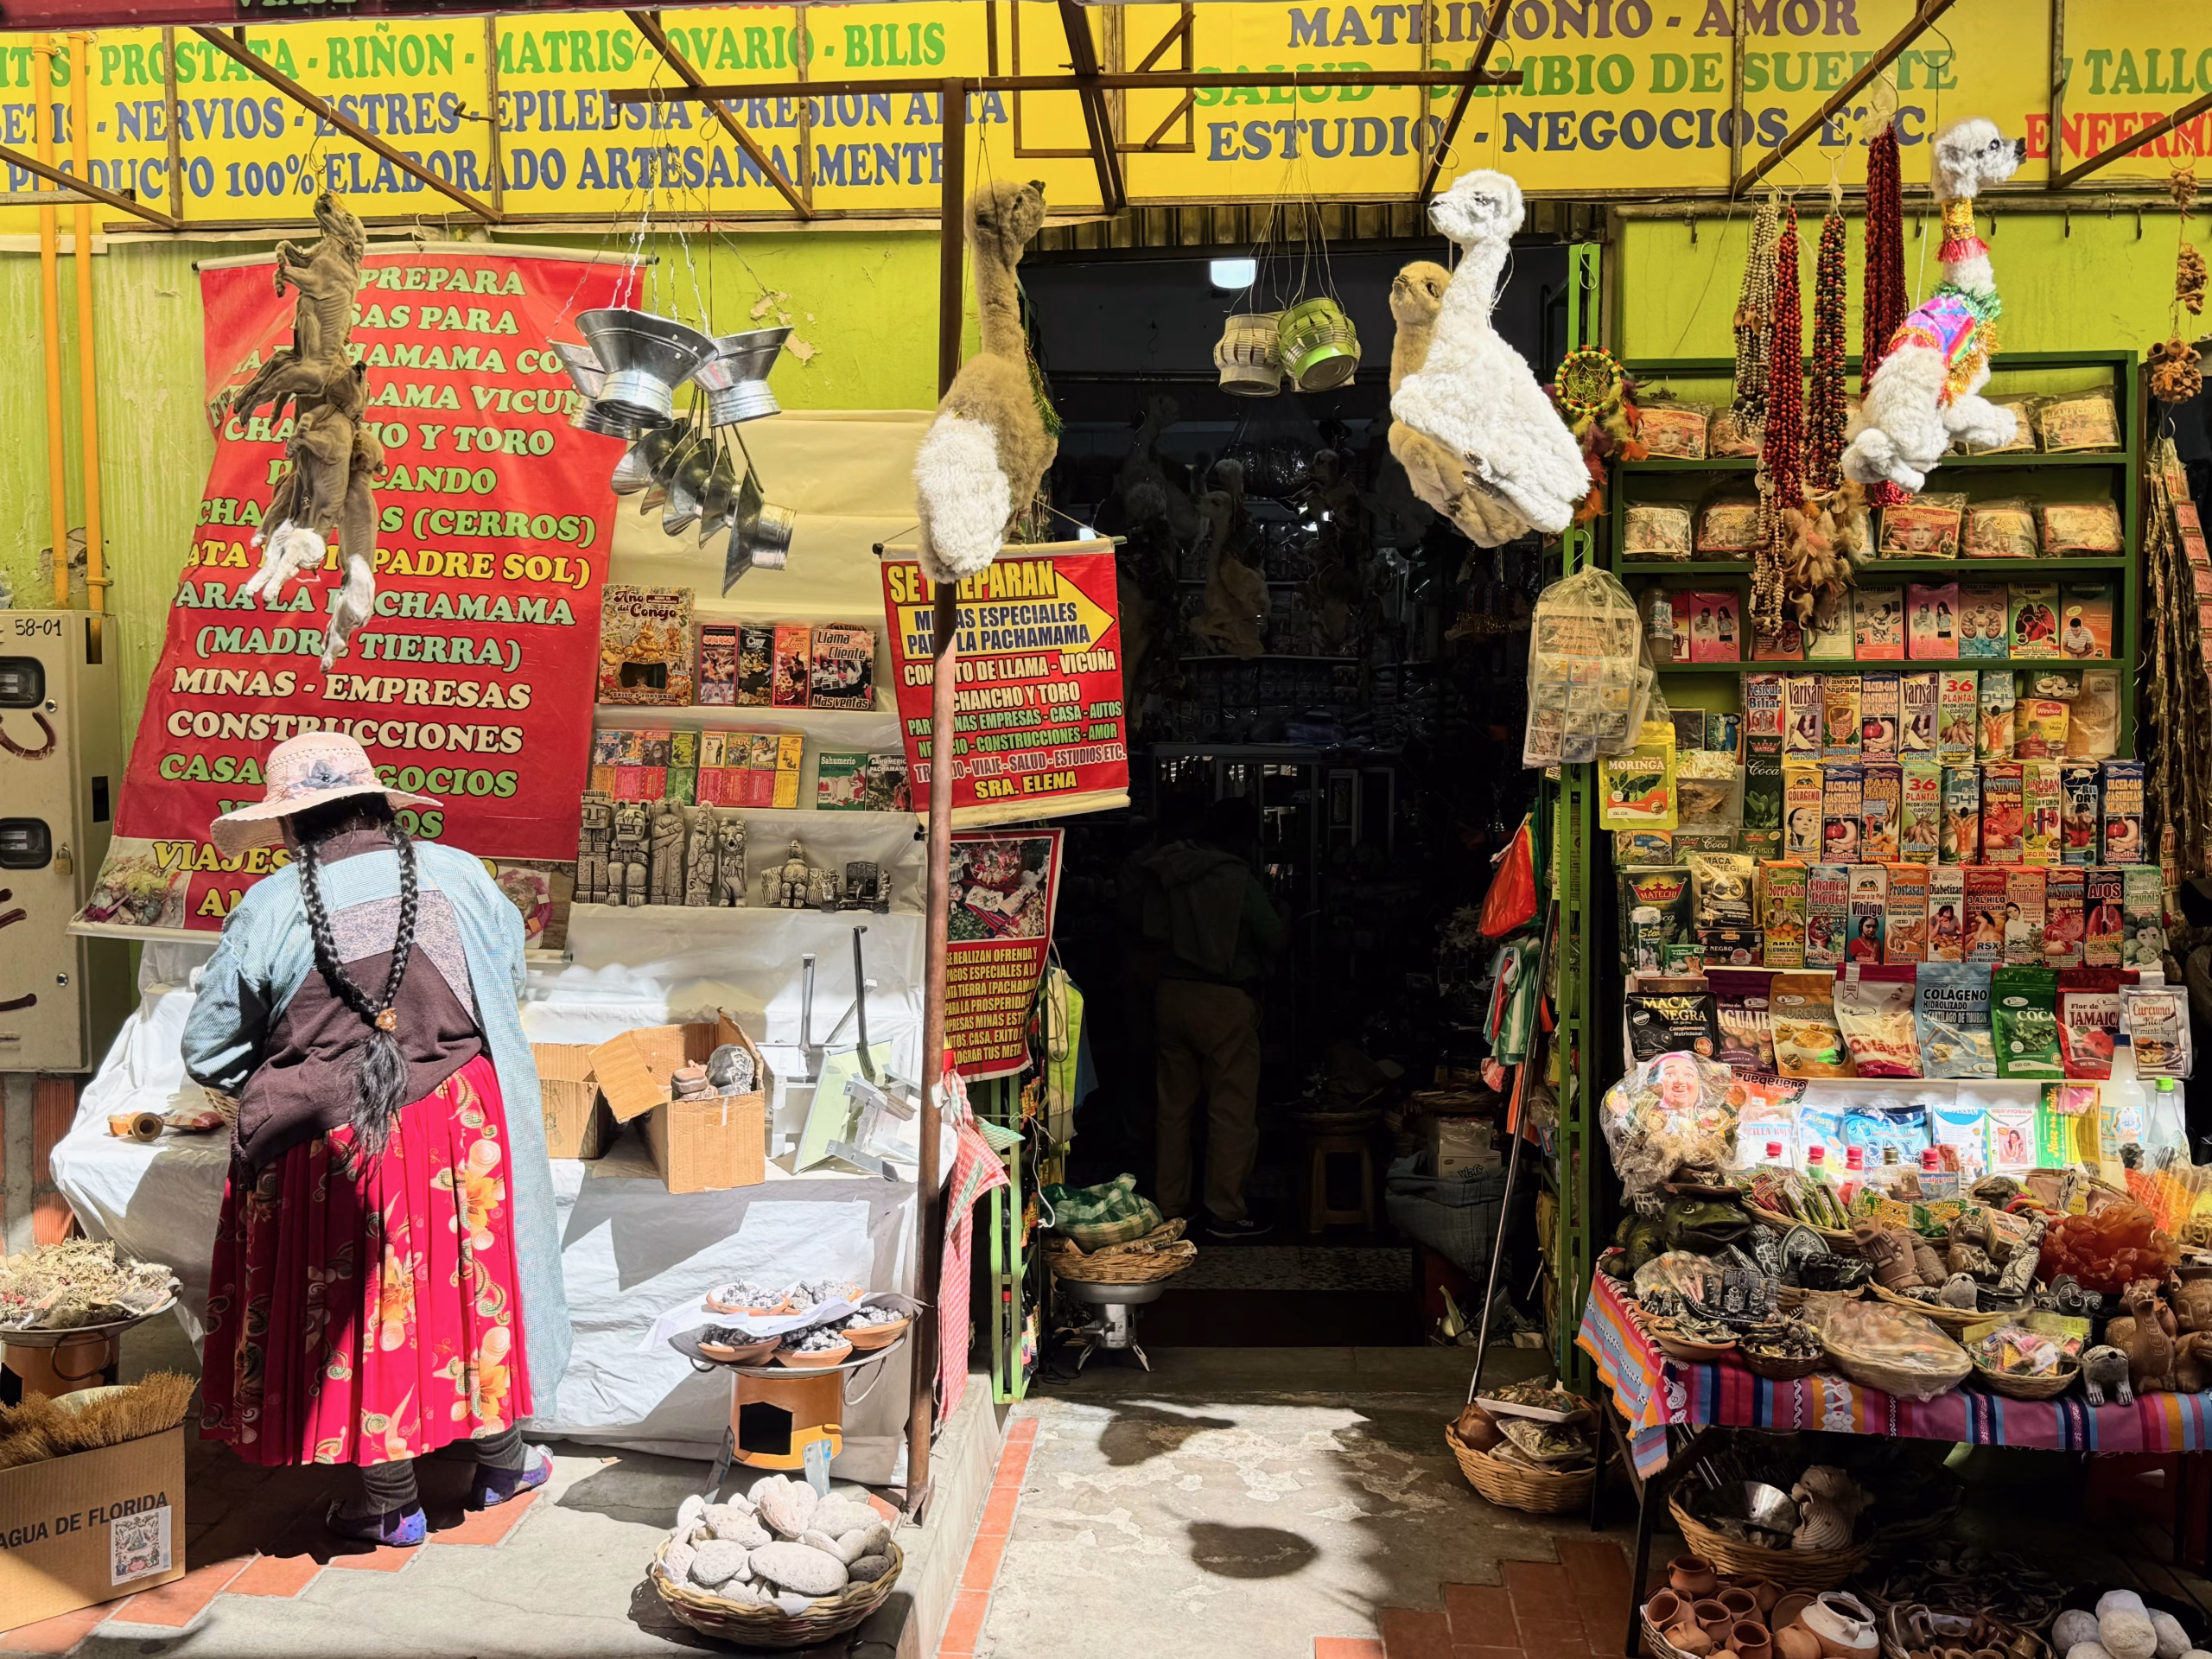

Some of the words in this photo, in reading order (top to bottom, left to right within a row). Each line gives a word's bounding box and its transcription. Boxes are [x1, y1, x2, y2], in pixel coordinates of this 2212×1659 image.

[1287, 0, 1654, 48] MATRIMONIO
[1694, 0, 1860, 37] AMOR
[99, 39, 299, 87] PROSTATA
[327, 22, 454, 79] RIÑON
[491, 29, 636, 74] MATRIS
[667, 26, 815, 72] OVARIO
[843, 22, 946, 68] BILIS
[1192, 61, 1375, 107] SALUD
[1648, 50, 1725, 94] DE
[115, 96, 285, 143] NERVIOS
[317, 92, 459, 137] ESTRES
[497, 89, 692, 132] EPILEPSIA
[722, 93, 892, 129] PRESION
[1207, 116, 1450, 162] ESTUDIO
[1503, 107, 1788, 152] NEGOCIOS
[226, 153, 315, 197] 100%
[325, 147, 567, 194] ELABORADO
[359, 266, 525, 296] PREPARA
[417, 304, 520, 335] PARA
[417, 423, 448, 451] Y
[452, 425, 556, 456] TORO
[411, 506, 597, 549] (CERROS)
[502, 552, 591, 590] SOL)
[887, 564, 922, 603] SE
[264, 585, 316, 613] LA
[613, 589, 645, 603] Año
[630, 603, 677, 621] Conejo
[978, 602, 1078, 628] ESPECIALES
[15, 619, 62, 637] 58-01
[817, 631, 851, 645] Llama
[957, 632, 978, 652] LA
[981, 624, 1091, 650] PACHAMAMA
[359, 631, 522, 673] TIERRA)
[828, 646, 867, 660] Cliente
[976, 660, 996, 681] DE
[998, 656, 1049, 680] LLAMA
[1058, 647, 1116, 675] VICUÑA
[172, 666, 297, 698] MINAS
[322, 673, 532, 711] EMPRESAS
[1863, 681, 1898, 692] ULCER-GAS
[1903, 681, 1938, 705] Varisan
[1946, 679, 1974, 692] 36
[812, 695, 834, 708] Mas
[835, 697, 870, 710] ventas
[953, 688, 1024, 712] CHANCHO
[1025, 686, 1038, 707] Y
[1038, 681, 1081, 705] TORO
[1789, 683, 1823, 706] Varisan
[1942, 693, 1976, 702] PLANTAS
[979, 709, 1042, 732] EMPRESAS
[1050, 704, 1082, 724] CASA
[1090, 700, 1122, 719] AUTOS
[2036, 707, 2062, 715] Windsor
[167, 709, 524, 755] CONSTRUCCIONES
[976, 727, 1081, 753] CONSTRUCCIONES
[1088, 722, 1118, 743] AMOR
[821, 756, 856, 766] Sahumerio
[971, 757, 1003, 777] VIAJE
[1008, 751, 1048, 772] SALUD
[1053, 746, 1104, 767] ESTUDIOS
[1104, 742, 1127, 761] ETC.
[1608, 760, 1666, 771] MORINGA
[1746, 760, 1781, 777] Coca
[974, 778, 1020, 799] SRA.
[1022, 770, 1077, 794] ELENA
[1826, 780, 1861, 792] ULCER-GAS
[1864, 778, 1900, 788] PAPA
[1908, 778, 1937, 791] 36
[1984, 779, 2022, 792] GASTRITIS
[2107, 779, 2142, 791] ULCER-GAS
[1864, 787, 1900, 798] MADRE
[1905, 792, 1939, 801] PLANTAS
[2106, 791, 2142, 802] GASTRIZAN
[1701, 836, 1729, 849] Coca
[1703, 855, 1731, 865] MACA
[1717, 863, 1751, 873] NEGRA
[1767, 881, 1805, 898] Borra-Cho
[1809, 878, 1847, 892] Chanca
[1888, 880, 1925, 897] Prostasan
[1929, 883, 1963, 895] Diabetizan
[2046, 884, 2083, 898] GASTRITIS
[2088, 884, 2122, 899] AJOS
[1640, 891, 1678, 900] MATECHI
[1811, 892, 1847, 905] Piedra
[2006, 889, 2044, 903] Valeriana
[2124, 892, 2161, 906] Graviola
[953, 950, 992, 965] REALIZAN
[994, 947, 1033, 963] OFRENDA
[1033, 946, 1038, 960] Y
[946, 967, 968, 983] PAGOS
[969, 963, 1022, 981] ESPECIALES
[1023, 963, 1029, 977] A
[1029, 962, 1037, 976] LA
[957, 982, 988, 998] TIERRA
[1923, 985, 1987, 1001] COLÁGENO
[960, 1000, 970, 1014] LA
[1643, 996, 1693, 1009] MACA
[1923, 1001, 1967, 1009] HIDROLIZADO
[2133, 1003, 2171, 1017] Curcuma
[976, 1013, 1005, 1029] MINAS
[1658, 1008, 1708, 1022] NEGRA
[1717, 1008, 1770, 1033] AGUAJE
[1928, 1011, 1957, 1024] CARTILAGO
[1957, 1011, 1965, 1023] DE
[1966, 1011, 1987, 1023] TIBURON
[2016, 1010, 2056, 1021] COCA
[994, 1027, 1020, 1043] EXITO
[954, 1048, 983, 1065] LOGRAR
[983, 1046, 1001, 1060] TUS
[1735, 1070, 1808, 1092] Guanabana
[1458, 1164, 1484, 1178] Wafs
[1933, 1201, 1960, 1210] Obrera
[0, 1522, 49, 1549] AGUA
[55, 1513, 82, 1535] DE
[88, 1491, 168, 1527] FLORIDA
